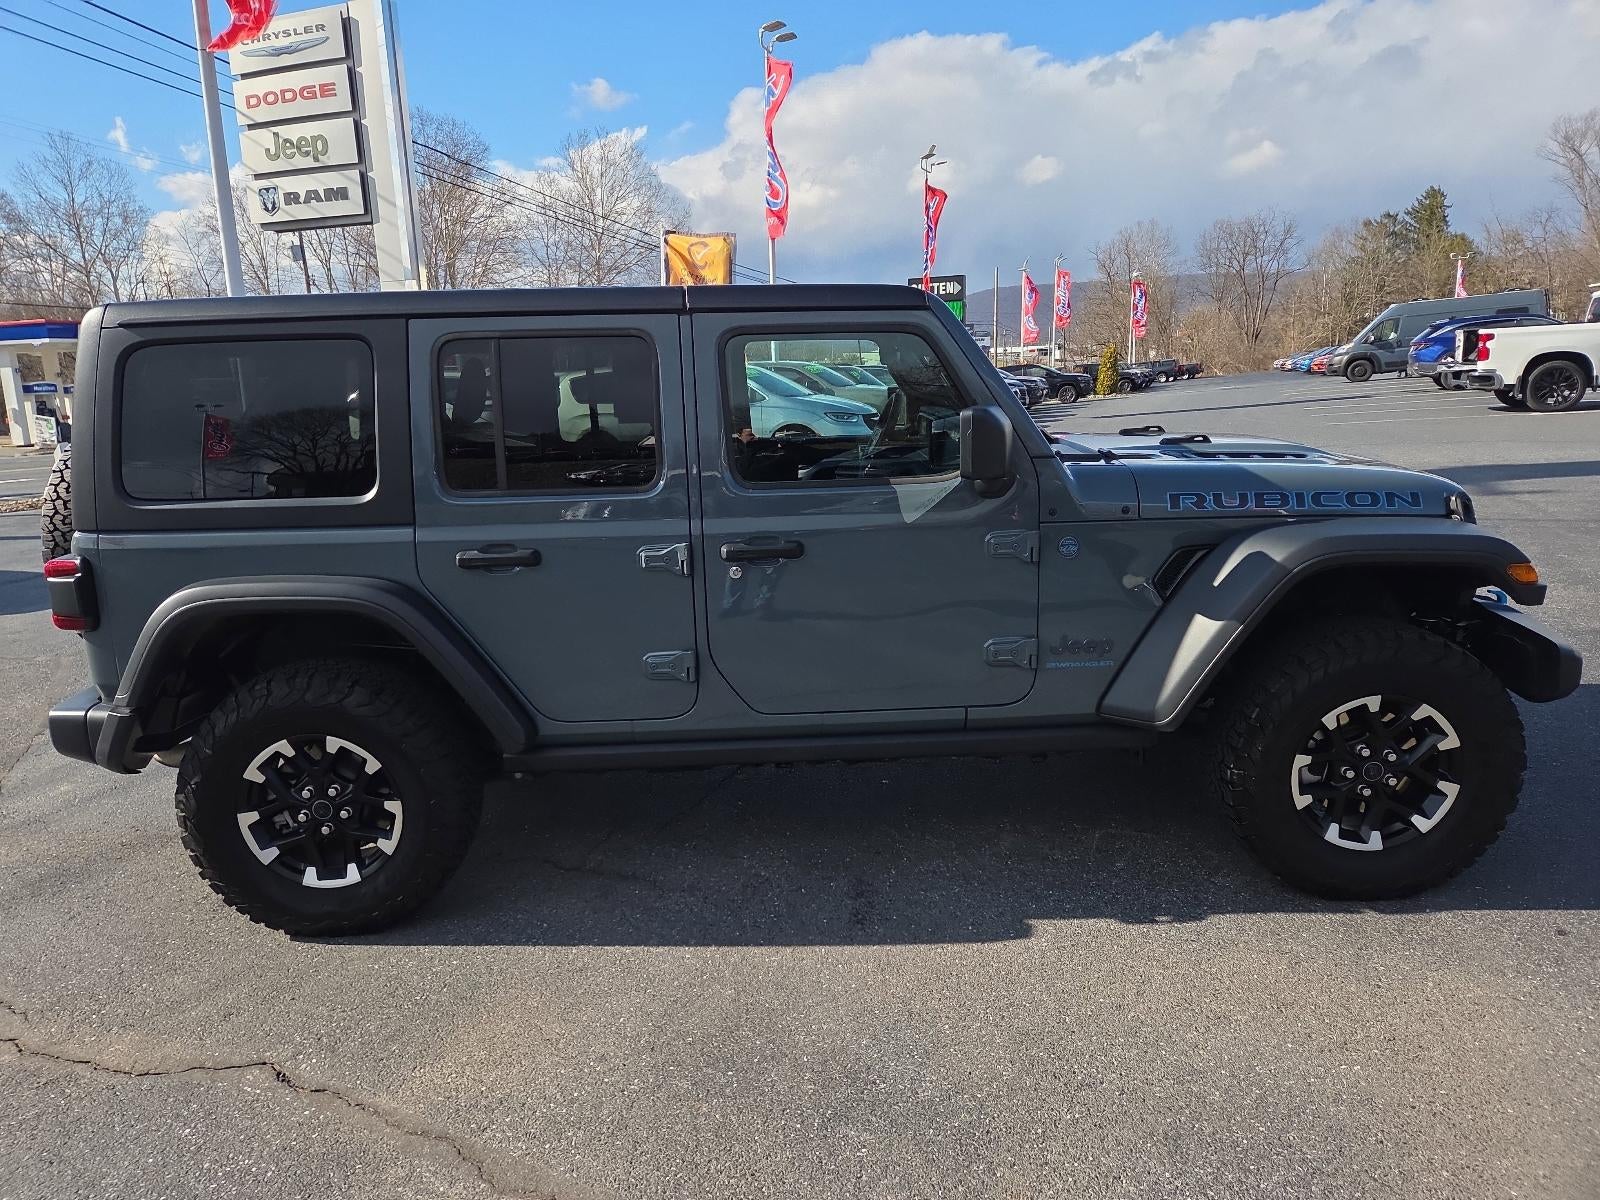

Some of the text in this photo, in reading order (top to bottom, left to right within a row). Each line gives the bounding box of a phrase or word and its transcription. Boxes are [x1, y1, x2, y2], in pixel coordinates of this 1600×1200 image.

[245, 82, 338, 110] DODGE
[264, 131, 329, 163] Jeep
[282, 186, 350, 206] RAM
[1166, 491, 1424, 511] RUBICON
[1049, 633, 1114, 658] Jeep
